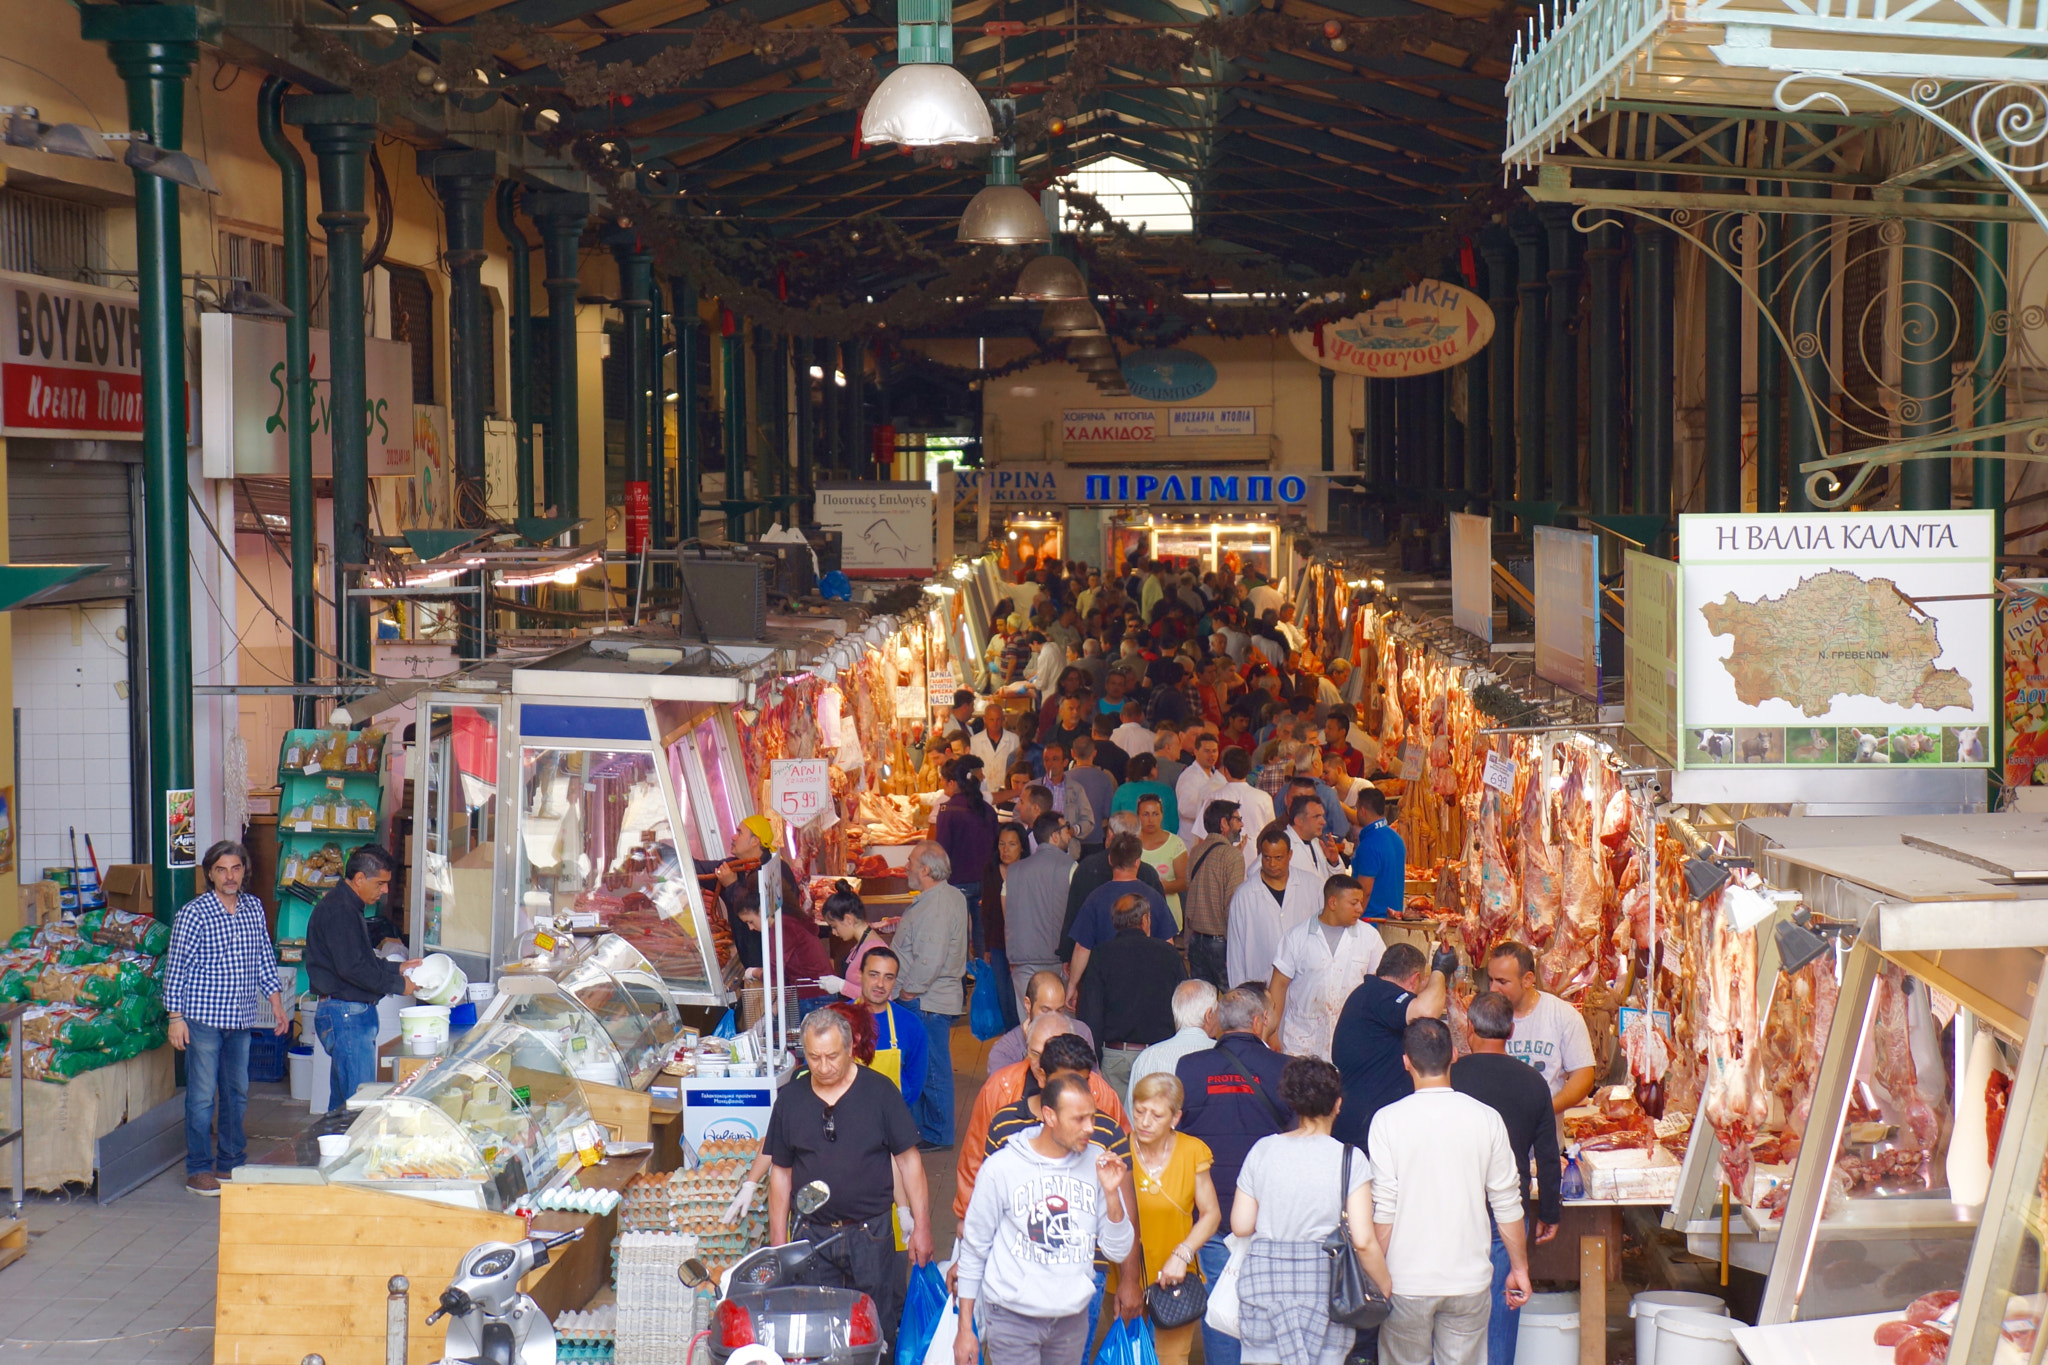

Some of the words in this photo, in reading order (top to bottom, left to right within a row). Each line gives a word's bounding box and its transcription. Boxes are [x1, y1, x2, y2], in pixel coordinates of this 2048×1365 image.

[1332, 335, 1459, 372] Ψαραγορά
[1064, 412, 1106, 422] ΧΟΙΡΙΝΑ
[1114, 412, 1155, 421] ΝΤΟΠΙΑ
[1174, 412, 1215, 423] ΜΟΣΧΑΡΙΑ
[1220, 410, 1250, 422] ΝΤΟΠΙΑ
[1065, 427, 1155, 440] ΧΑΛΚΙΔΟΣ
[956, 490, 1056, 500] ΧΚΙΔΟΣ
[1086, 475, 1306, 502] ΠΙΡΛΙΜΠΟ
[823, 494, 876, 508] Ποιοτικές
[879, 494, 926, 508] Επιλογές
[1716, 526, 1739, 550] Η
[1747, 525, 1834, 550] ΒΑΛΙΑ
[1841, 524, 1958, 549] ΚΑΛΝΤΑ
[2032, 638, 2048, 657] Κ
[1831, 651, 1889, 660] ΓΡΕΒΕΝΩΝ
[930, 695, 954, 704] ΝΑΞΟΥ
[1207, 1074, 1260, 1084] PROTEA
[1013, 1175, 1097, 1217] CLEVER
